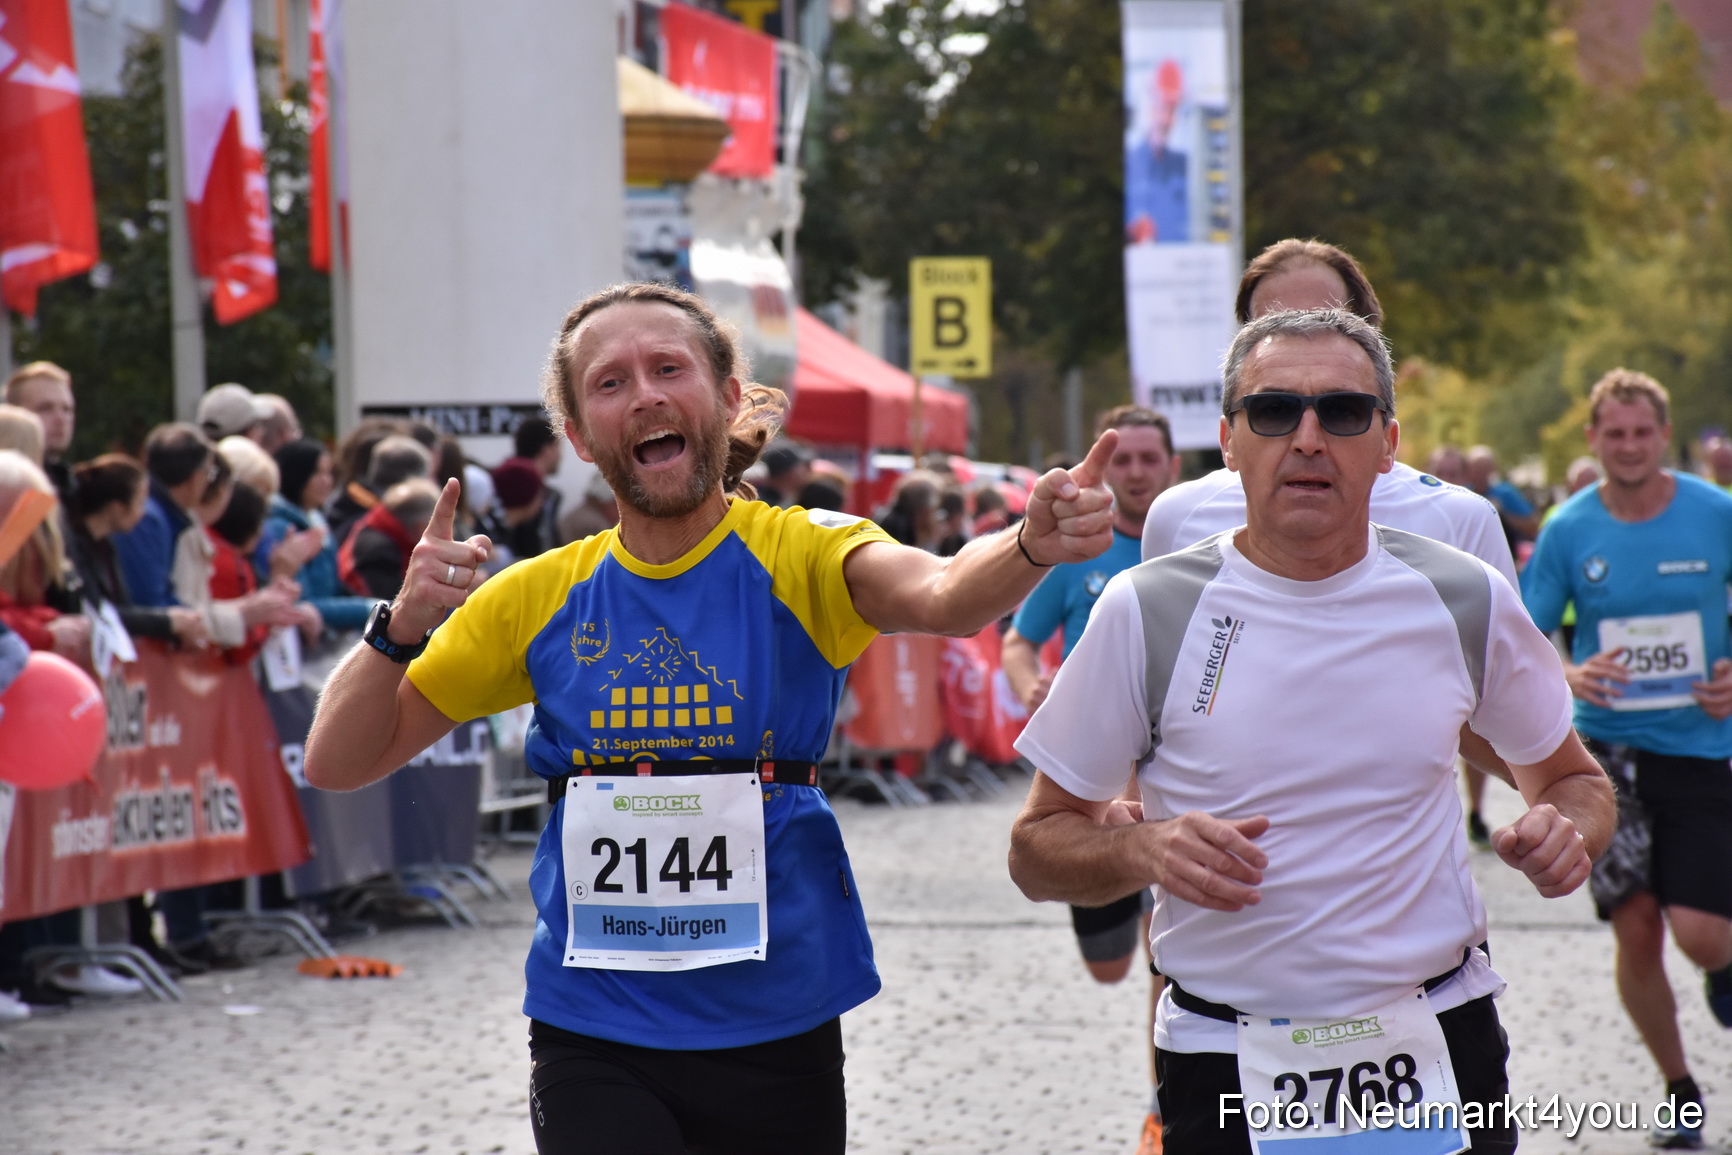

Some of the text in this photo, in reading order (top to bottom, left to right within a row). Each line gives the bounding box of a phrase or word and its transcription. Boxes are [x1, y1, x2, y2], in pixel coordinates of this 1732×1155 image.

[933, 296, 967, 349] B
[577, 634, 602, 647] ahre
[582, 622, 595, 633] 15
[1618, 643, 1688, 673] 2595
[1192, 631, 1228, 714] SEEBERGER
[592, 734, 735, 752] 21.September 2014
[632, 795, 702, 812] BOCK
[591, 835, 733, 894] 2144
[575, 885, 583, 896] C
[602, 915, 726, 940] Hans-Jürgen
[1313, 1016, 1383, 1043] BOCK
[1273, 1053, 1424, 1128] 2768
